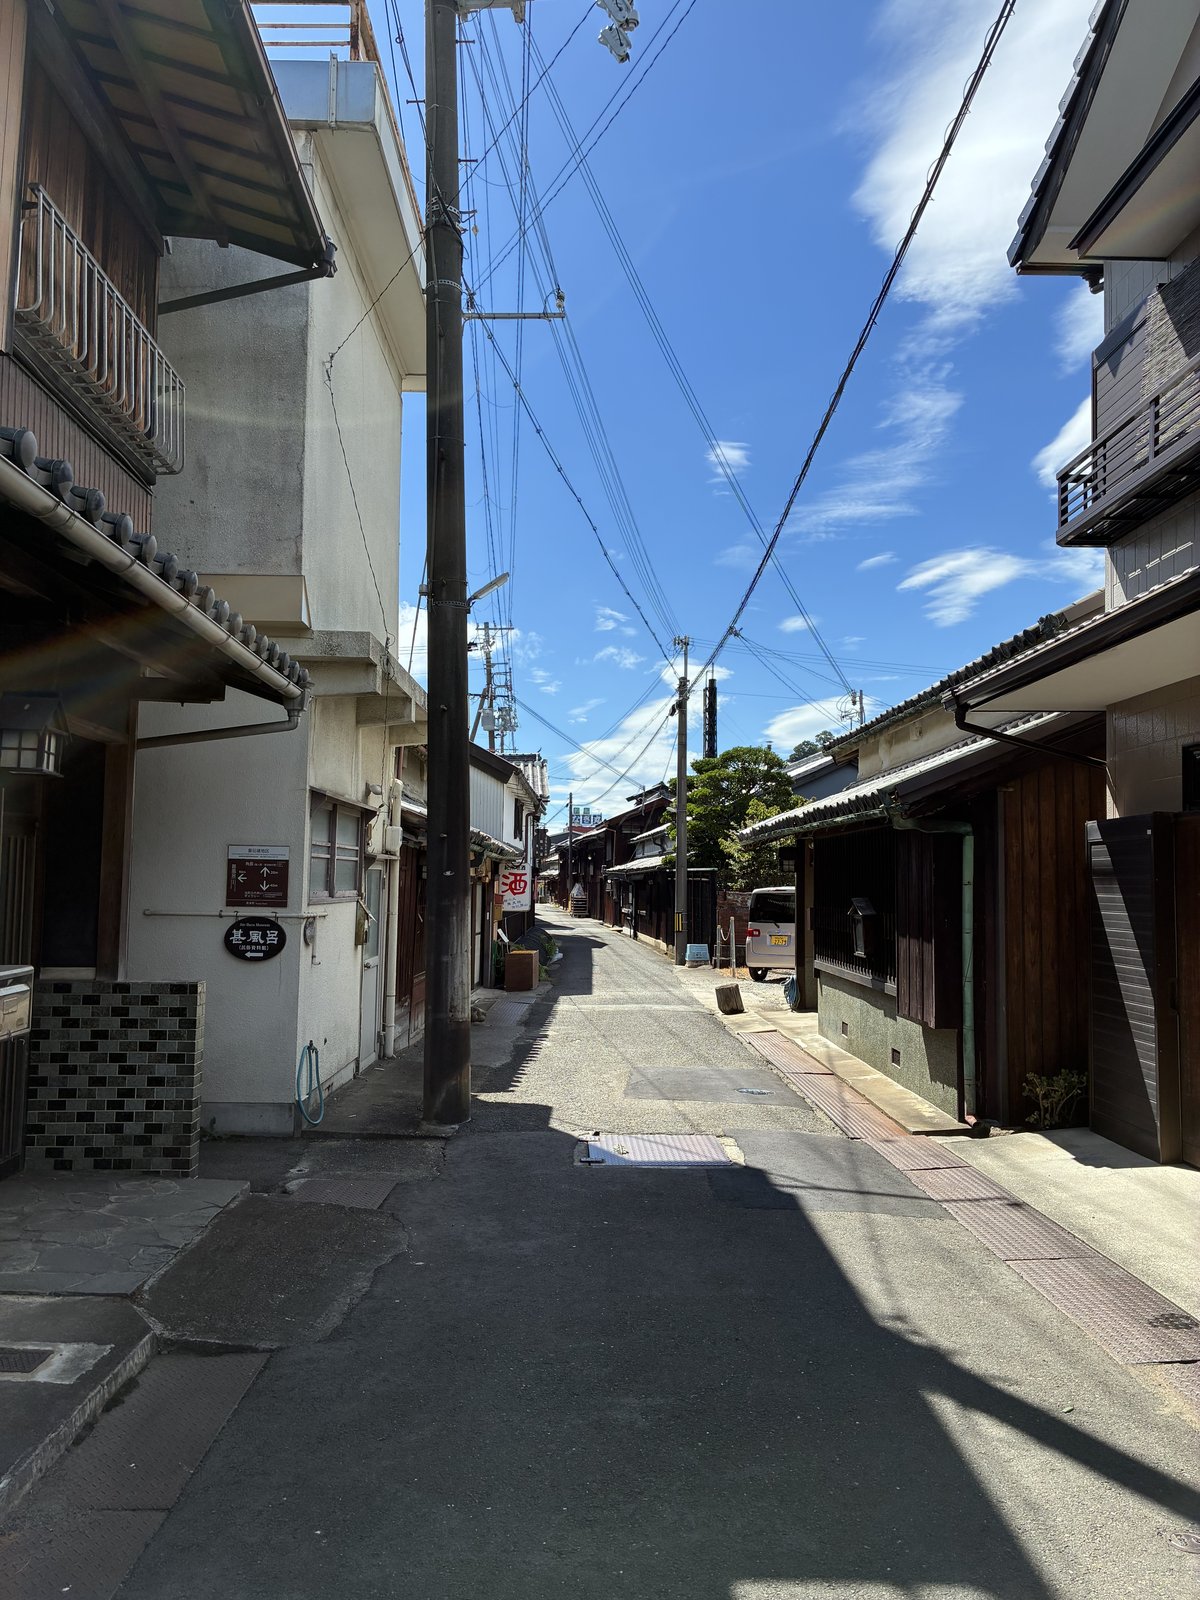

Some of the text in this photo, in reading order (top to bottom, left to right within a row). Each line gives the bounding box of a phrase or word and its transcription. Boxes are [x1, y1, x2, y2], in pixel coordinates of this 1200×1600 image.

[501, 872, 528, 896] 酒
[229, 928, 279, 944] 甚風呂
